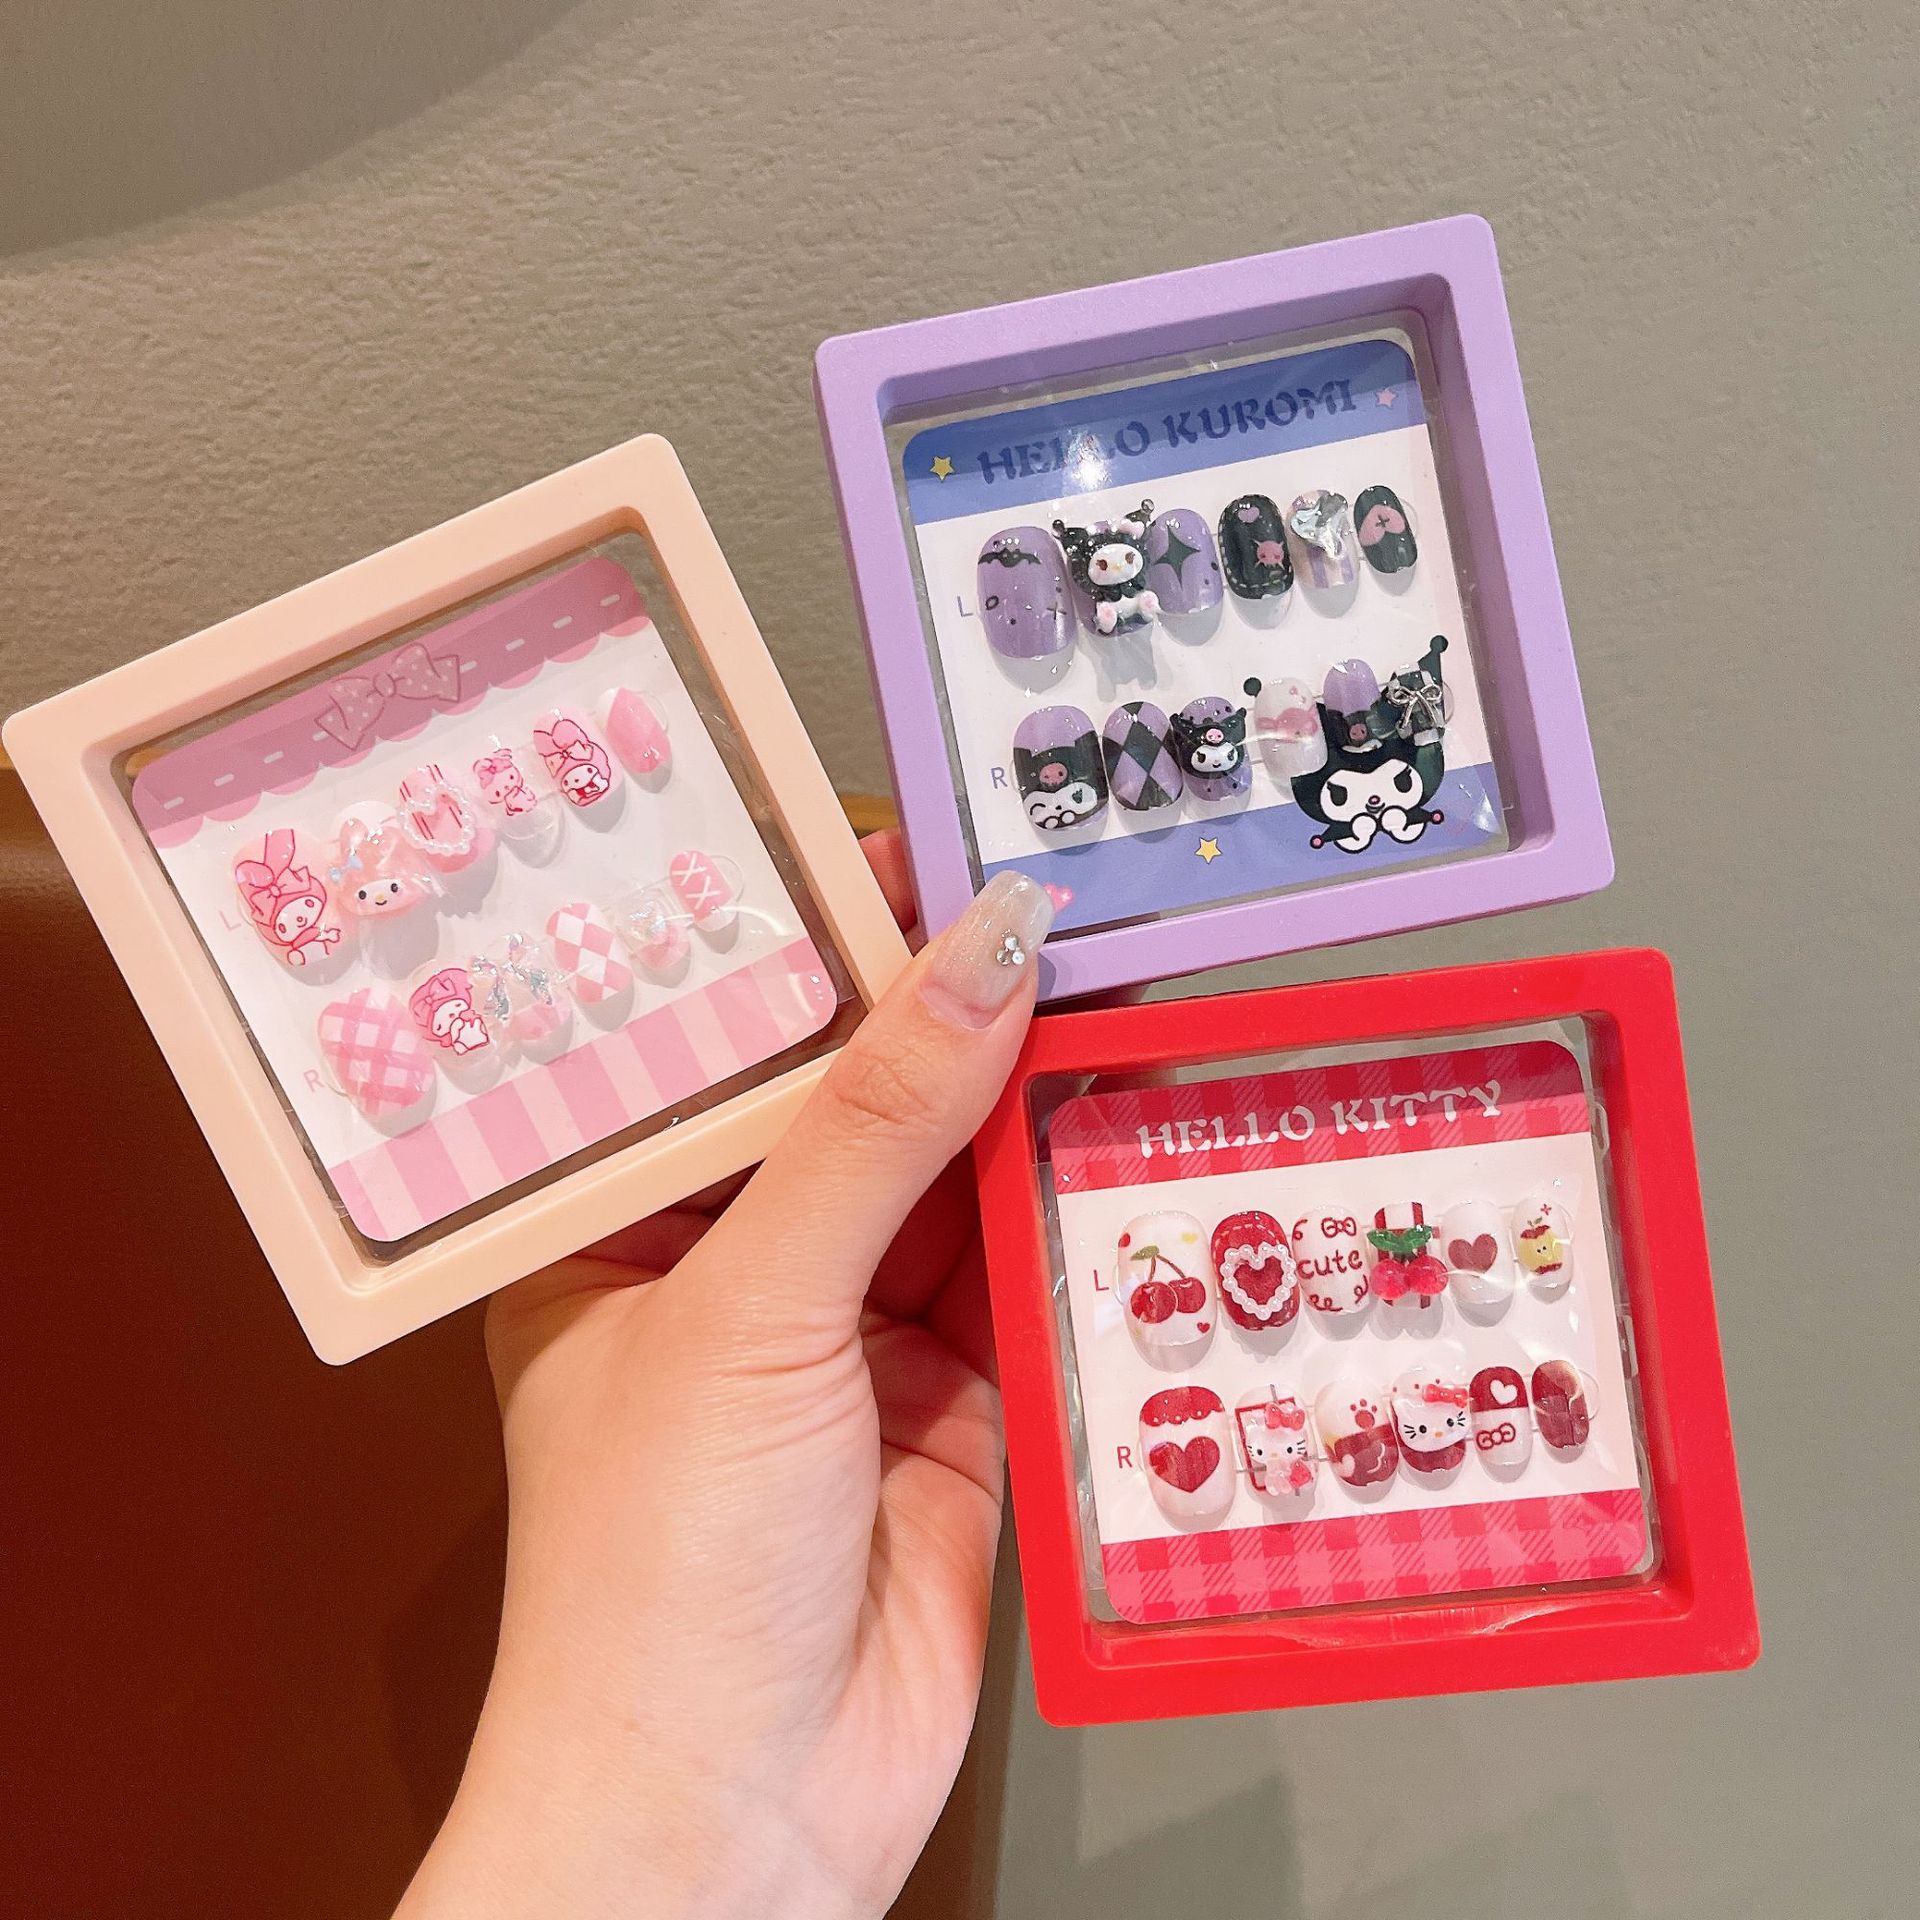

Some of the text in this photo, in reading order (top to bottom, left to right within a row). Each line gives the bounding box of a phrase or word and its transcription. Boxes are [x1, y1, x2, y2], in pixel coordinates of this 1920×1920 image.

[976, 380, 1357, 485] HELO KUROMI
[957, 596, 974, 617] L
[991, 767, 1008, 789] R
[221, 910, 238, 931] L
[305, 1069, 325, 1092] R
[1136, 1079, 1503, 1159] HELLO KITTY
[1297, 1250, 1363, 1279] cute
[1094, 1269, 1109, 1291] L
[1117, 1446, 1132, 1468] R
